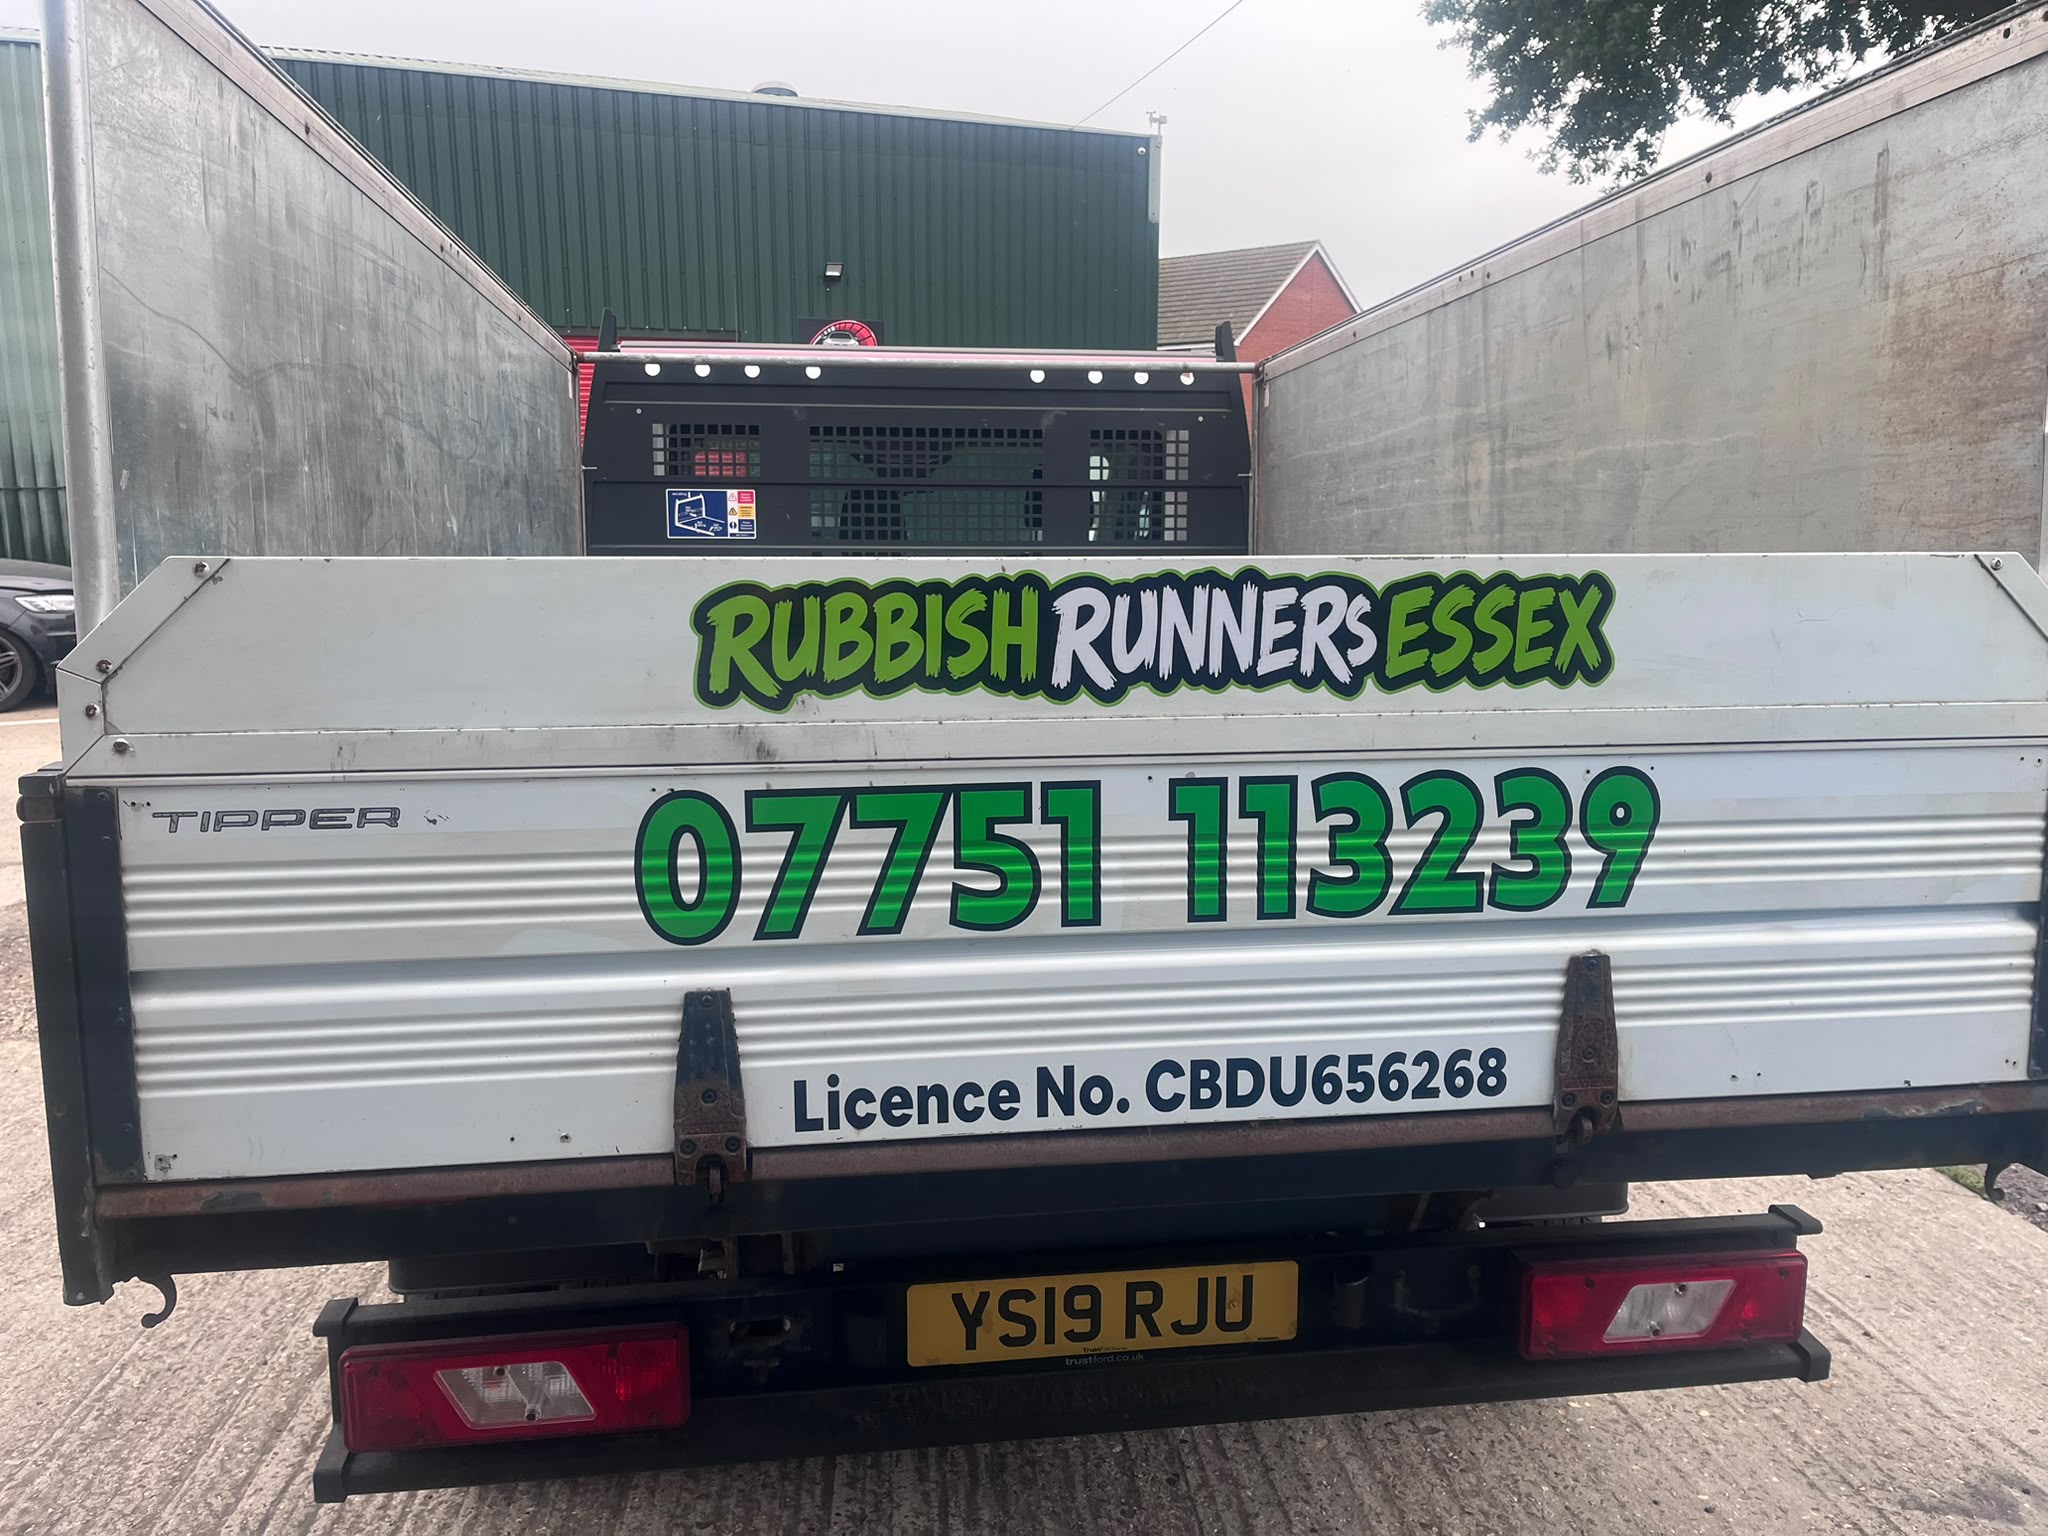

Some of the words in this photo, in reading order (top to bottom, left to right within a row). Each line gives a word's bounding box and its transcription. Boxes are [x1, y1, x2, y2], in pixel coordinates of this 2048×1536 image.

[705, 584, 1038, 700] RUBBISH
[1051, 583, 1377, 691] RUNNERS
[1386, 584, 1605, 678] ESSEX
[152, 807, 400, 833] TIPPER
[634, 779, 1102, 946] 07751
[1168, 766, 1661, 924] 113239
[792, 1073, 1020, 1133] Licence
[1036, 1065, 1130, 1118] No.
[1145, 1047, 1508, 1112] CBDU656268
[951, 1284, 1102, 1351] YS19
[1124, 1274, 1254, 1340] RJU
[1065, 1352, 1145, 1366] trustford.co.uk
